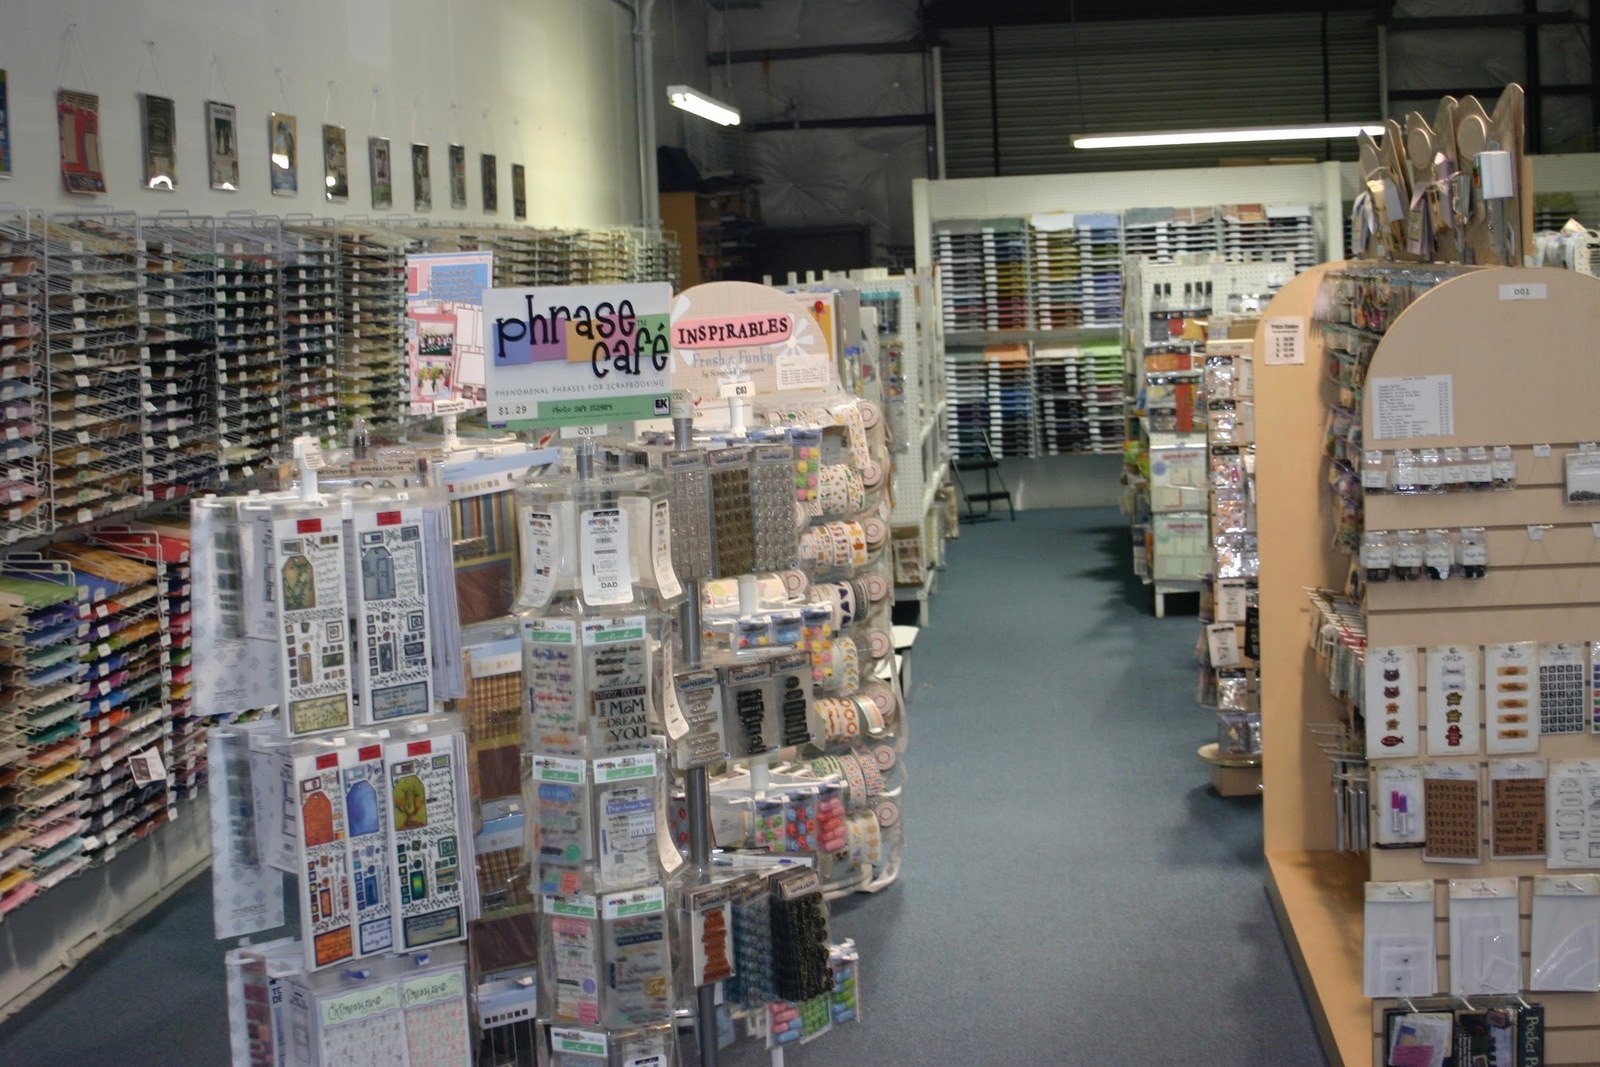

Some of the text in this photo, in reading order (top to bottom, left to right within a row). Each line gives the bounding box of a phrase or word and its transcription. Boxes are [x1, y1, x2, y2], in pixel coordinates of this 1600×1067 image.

[496, 294, 635, 358] phrase
[678, 317, 788, 345] INSPIRABLES
[592, 322, 669, 378] café
[739, 347, 774, 366] Funky
[495, 379, 665, 397] PHENOMENAL PHRASES FOR SCRAPBOOKING
[498, 405, 528, 416] $1.29
[655, 398, 668, 409] EK
[577, 426, 594, 436] C01
[610, 726, 648, 742] YOU
[1525, 1015, 1540, 1053] Pocket
